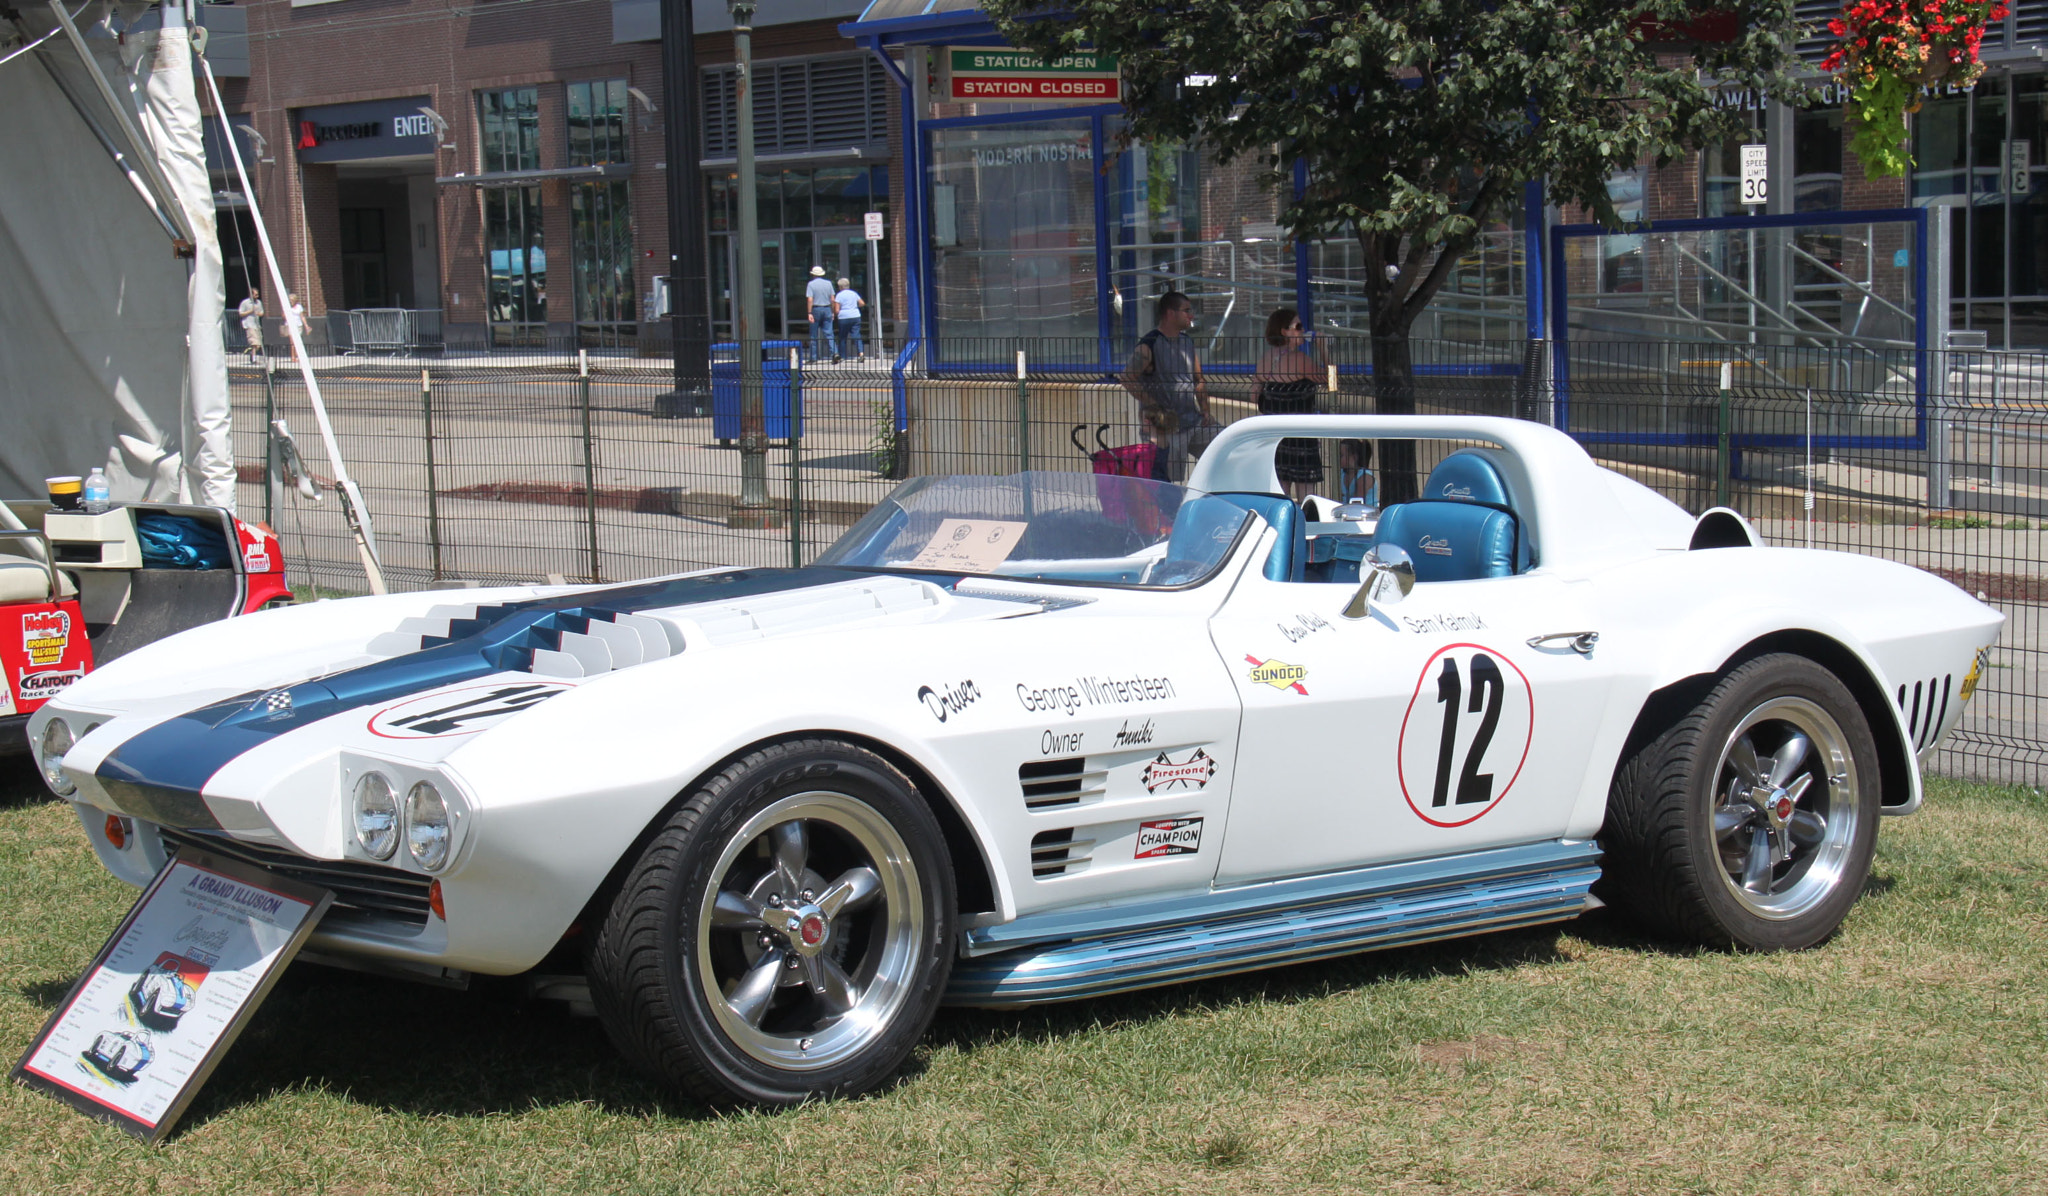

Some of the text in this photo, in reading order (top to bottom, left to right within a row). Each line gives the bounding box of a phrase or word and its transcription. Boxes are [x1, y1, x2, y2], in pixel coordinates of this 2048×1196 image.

[974, 55, 1043, 69] STATION
[963, 81, 1106, 95] STATION CLOSED
[974, 146, 1033, 167] MODERN
[1748, 150, 1764, 158] CITY
[1747, 169, 1765, 177] LIMIT
[1745, 178, 1767, 199] 30
[24, 614, 63, 633] Holley
[1403, 616, 1440, 633] Sam
[27, 637, 66, 649] SPORTSMAN
[29, 674, 75, 689] FLATOUT
[1253, 666, 1303, 682] SUNOCO
[20, 690, 44, 698] Race
[917, 674, 1176, 723] Driver George Wintersteen
[387, 684, 567, 734] 12
[1041, 718, 1155, 755] Owner Anniki
[1432, 653, 1504, 807] 12
[1152, 766, 1205, 780] Firestone
[1140, 830, 1198, 845] CHAMPION
[188, 873, 202, 888] A
[199, 876, 236, 898] GRAND
[231, 887, 283, 915] ILLUSION
